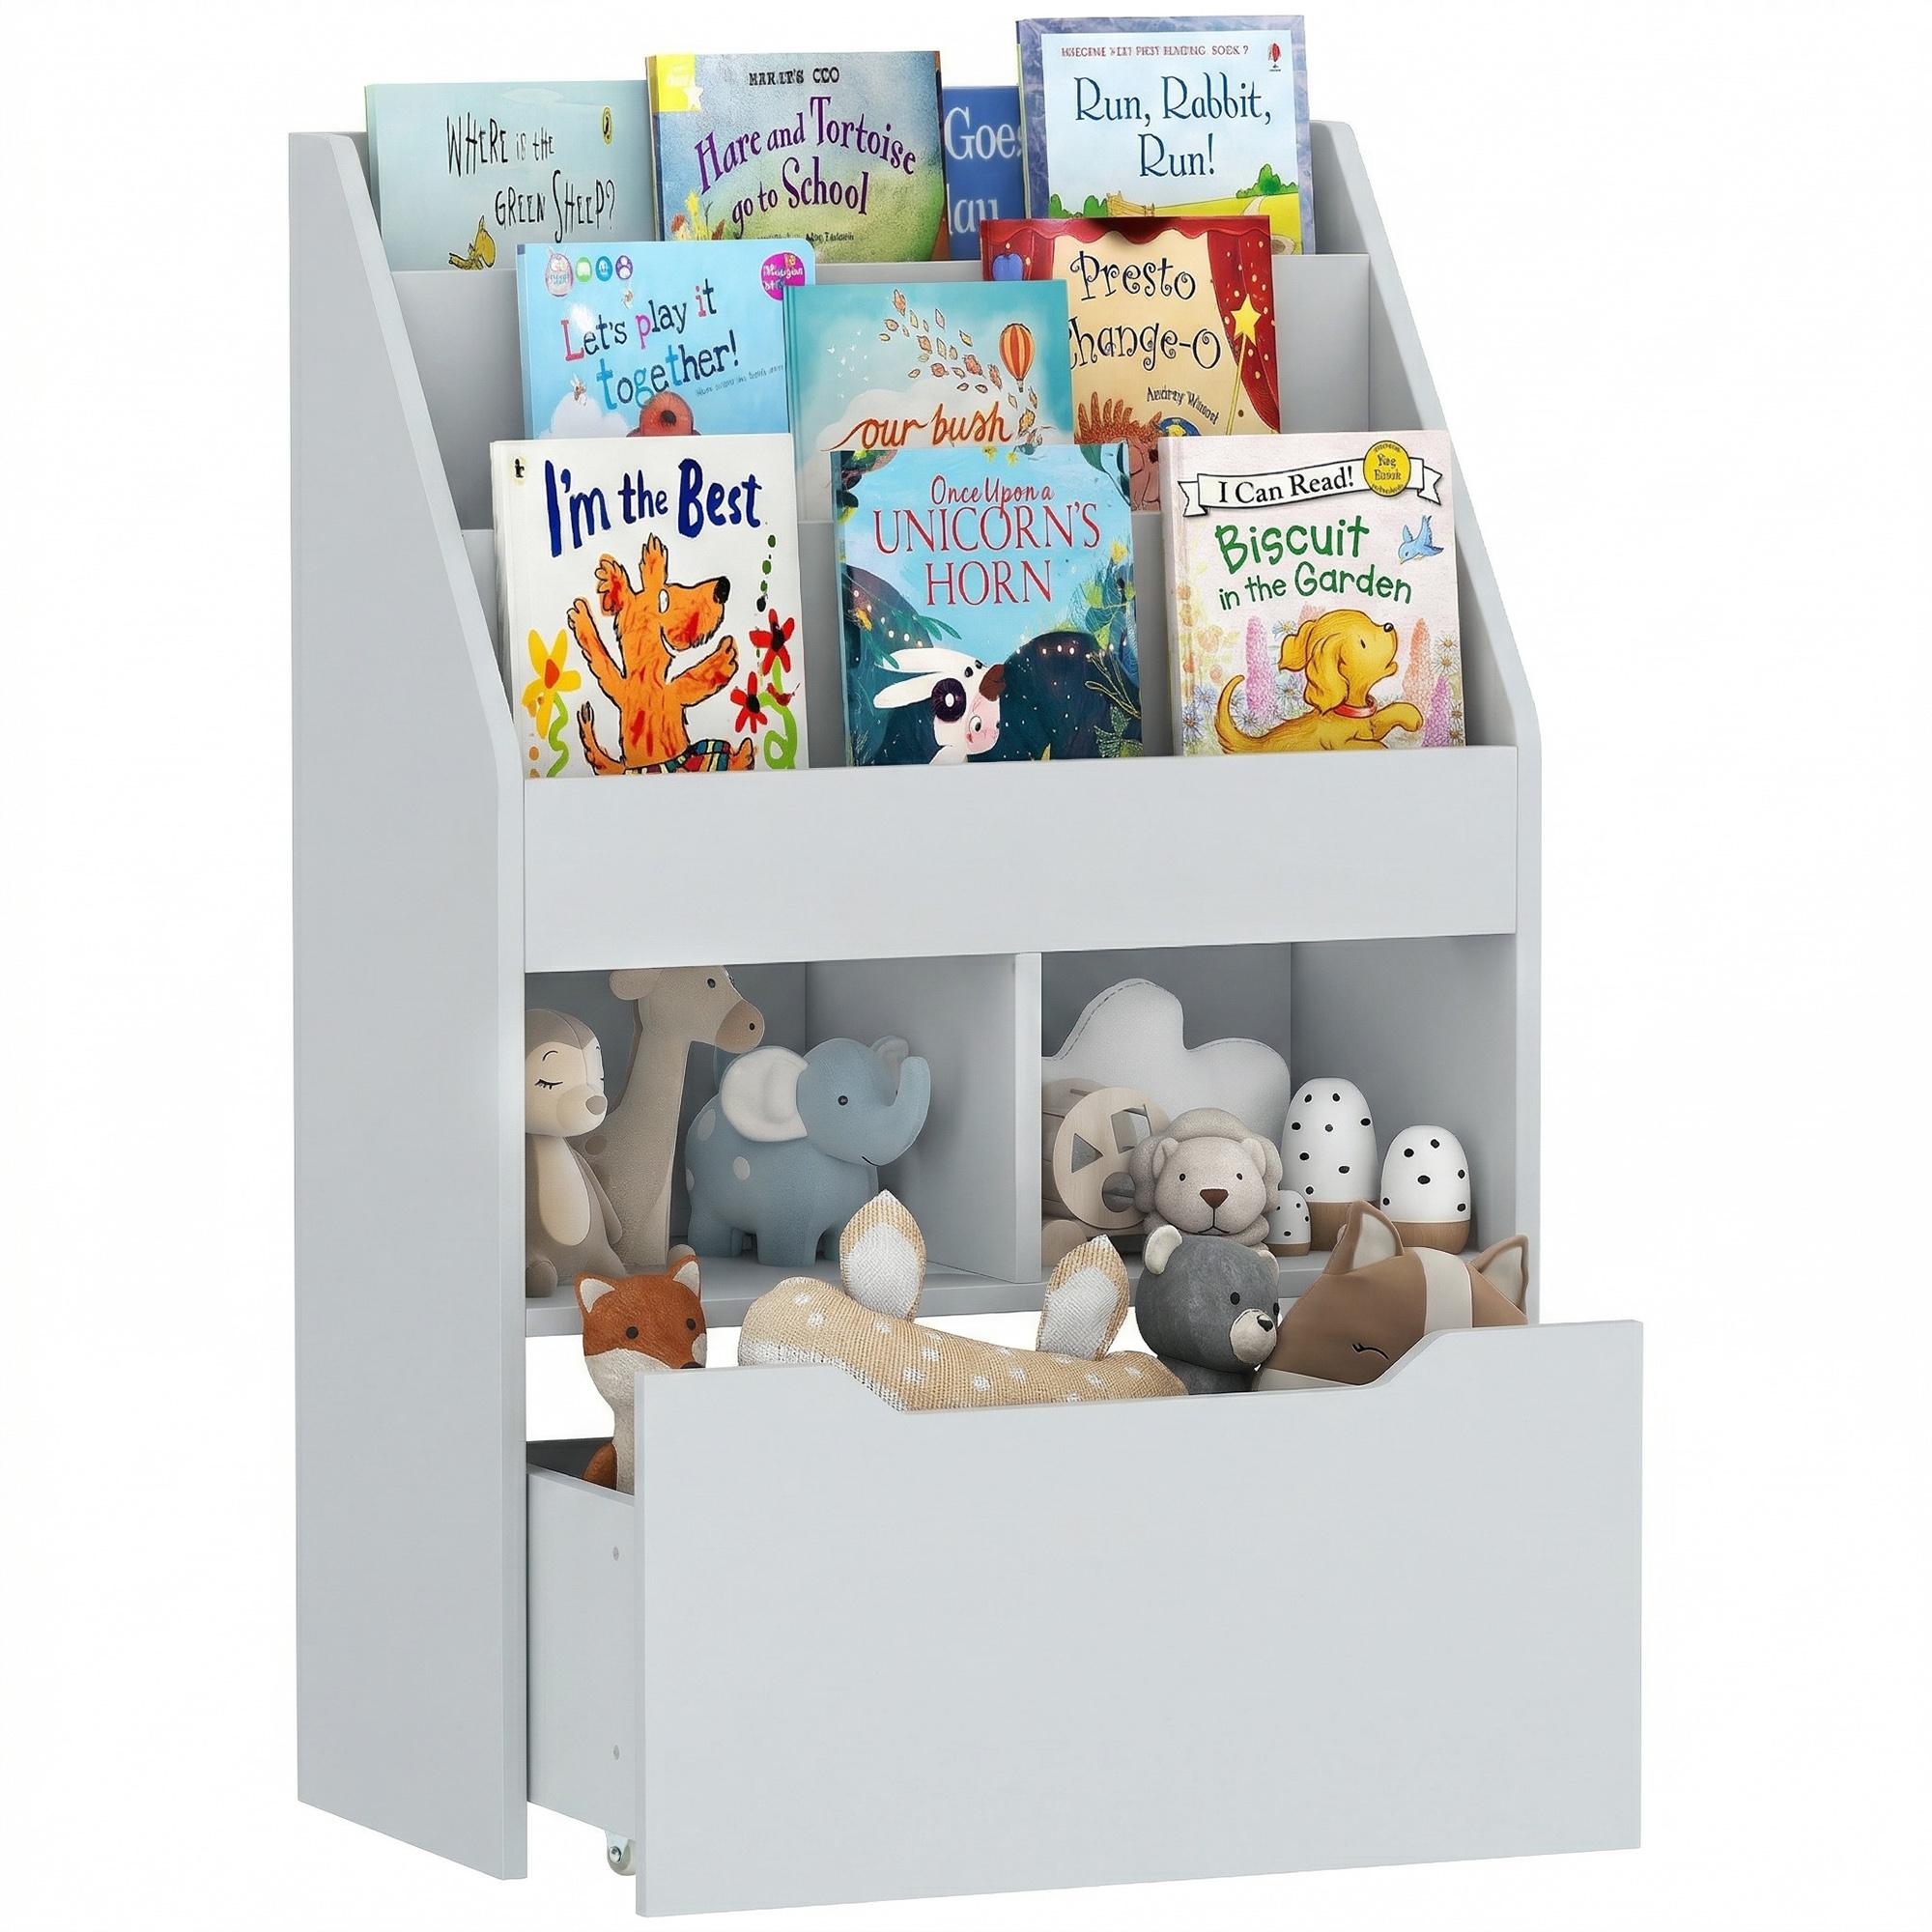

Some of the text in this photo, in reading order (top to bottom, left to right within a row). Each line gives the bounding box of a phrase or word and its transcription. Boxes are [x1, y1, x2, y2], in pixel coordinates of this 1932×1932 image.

[1074, 71, 1271, 127] Run, Rabbit,
[446, 112, 508, 178] WHERE
[694, 96, 917, 195] Hare and Tortoise
[1138, 131, 1215, 178] Run!
[495, 185, 546, 230] GREEN
[731, 156, 868, 240] go to School
[1069, 250, 1197, 301] Presto
[560, 278, 718, 361] Let's play it
[595, 329, 739, 410] together!
[821, 401, 1012, 451] our bush
[545, 458, 762, 557] I'm the Best
[931, 474, 1054, 519] Once Upon a
[1218, 482, 1230, 503] I
[1236, 479, 1285, 503] Can
[1290, 466, 1355, 497] Read!
[873, 502, 1101, 554] UNICORN'S
[1214, 516, 1370, 575] Biscuit
[924, 560, 1053, 606] HORN
[1219, 561, 1413, 611] in the Garden
